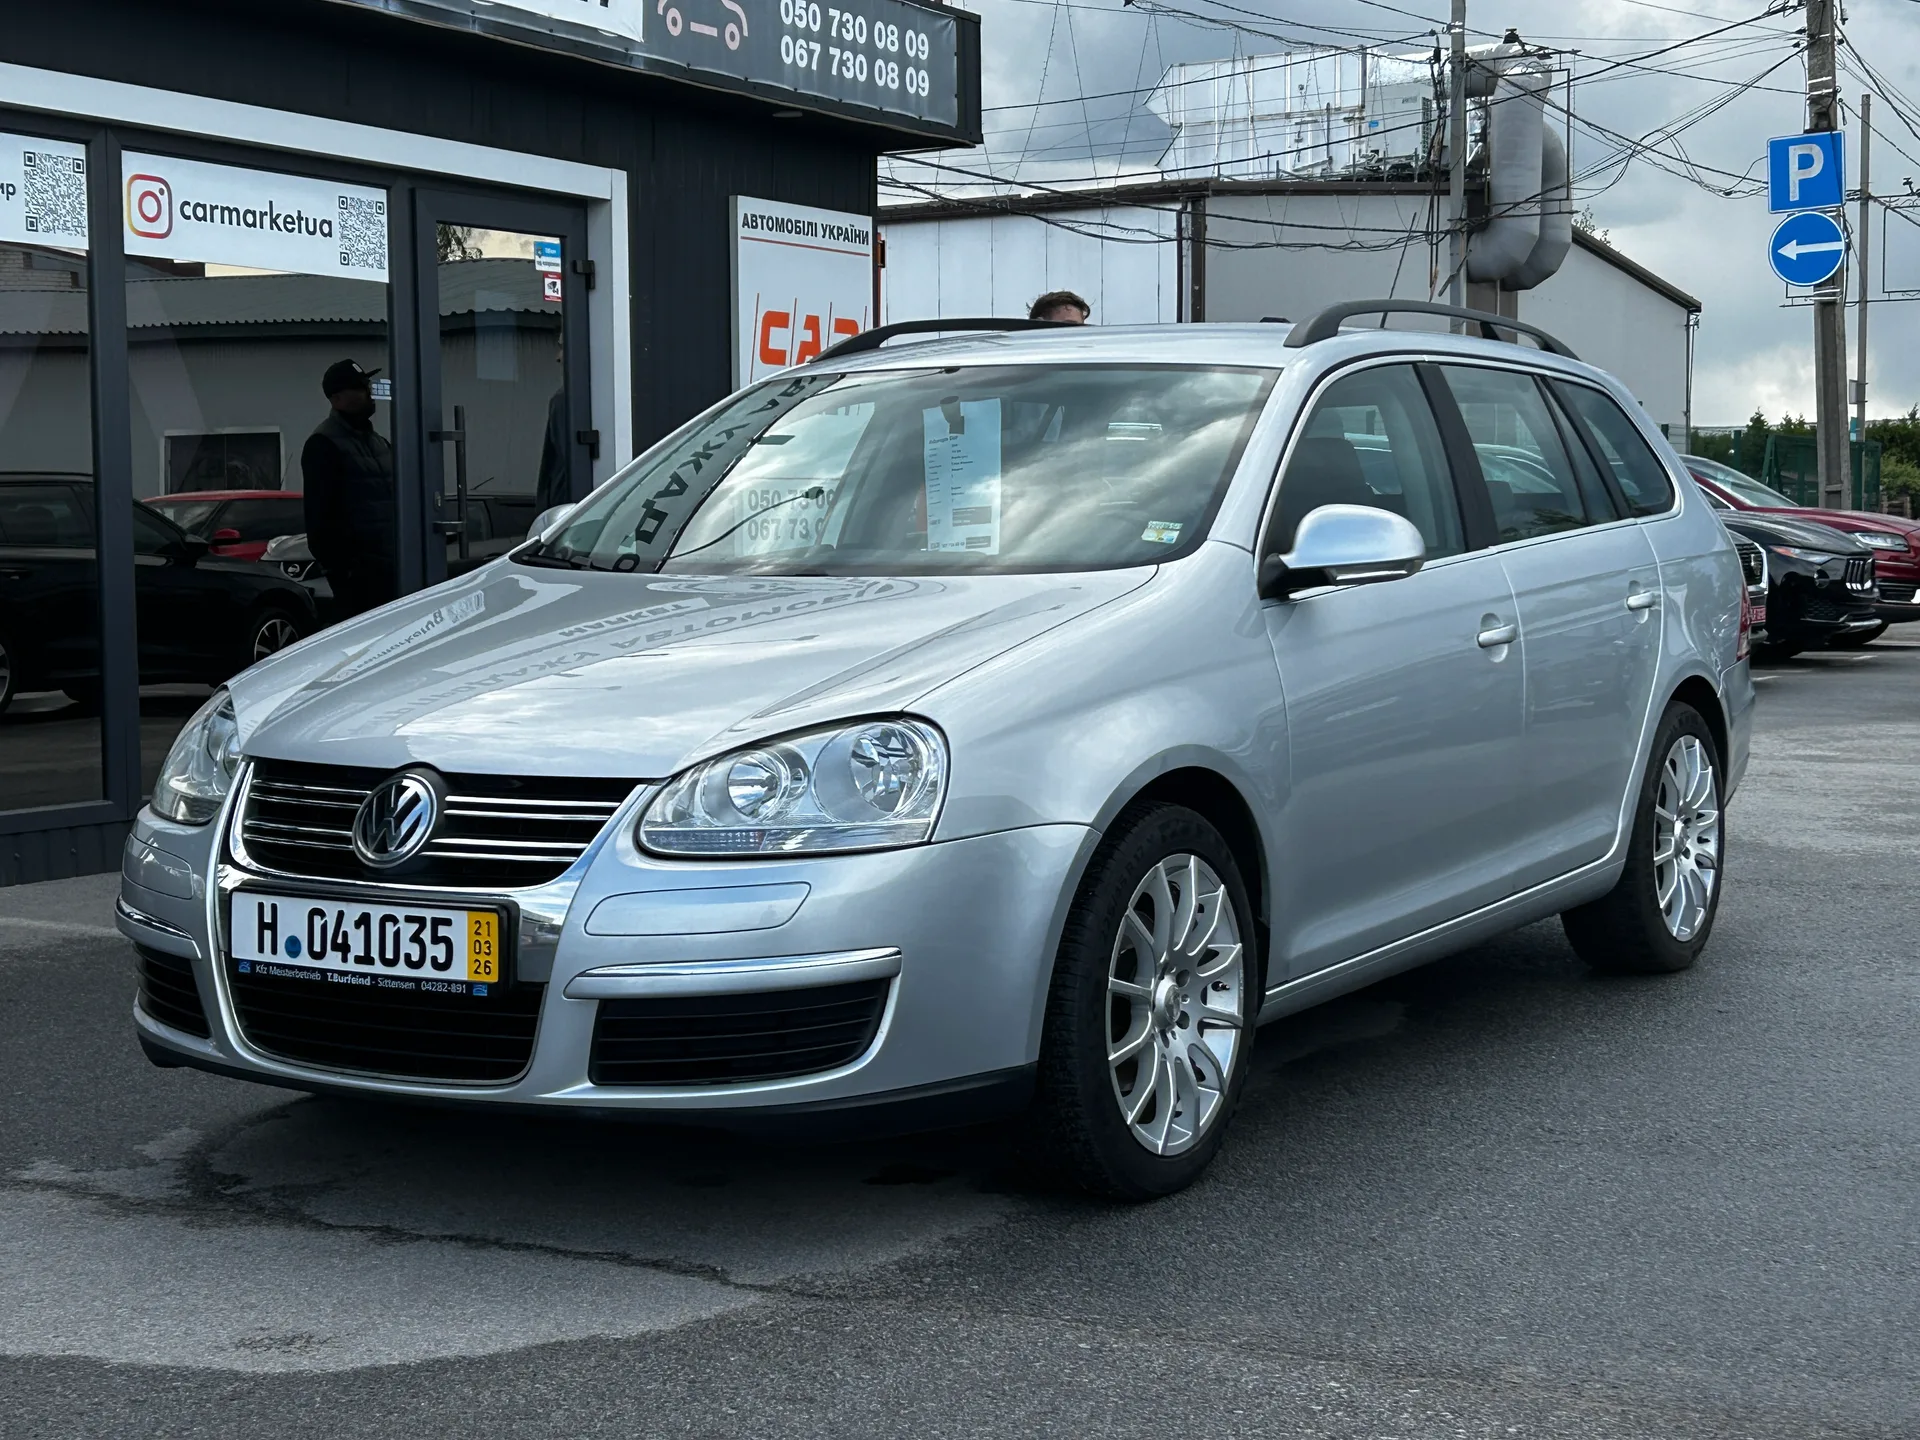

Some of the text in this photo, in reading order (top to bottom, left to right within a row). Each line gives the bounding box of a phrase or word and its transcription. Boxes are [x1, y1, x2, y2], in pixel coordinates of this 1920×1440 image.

[780, 0, 929, 60] 050 730 08 09
[780, 35, 929, 97] 067 730 08 09
[1788, 143, 1825, 202] P
[179, 198, 333, 239] carmarketua
[741, 212, 869, 246] АВТОМОБІЛІ УКРАЇНИ
[748, 518, 782, 540] 067
[257, 901, 454, 972] H 041035
[473, 919, 492, 937] 21
[473, 939, 492, 957] 03
[473, 958, 492, 976] 26
